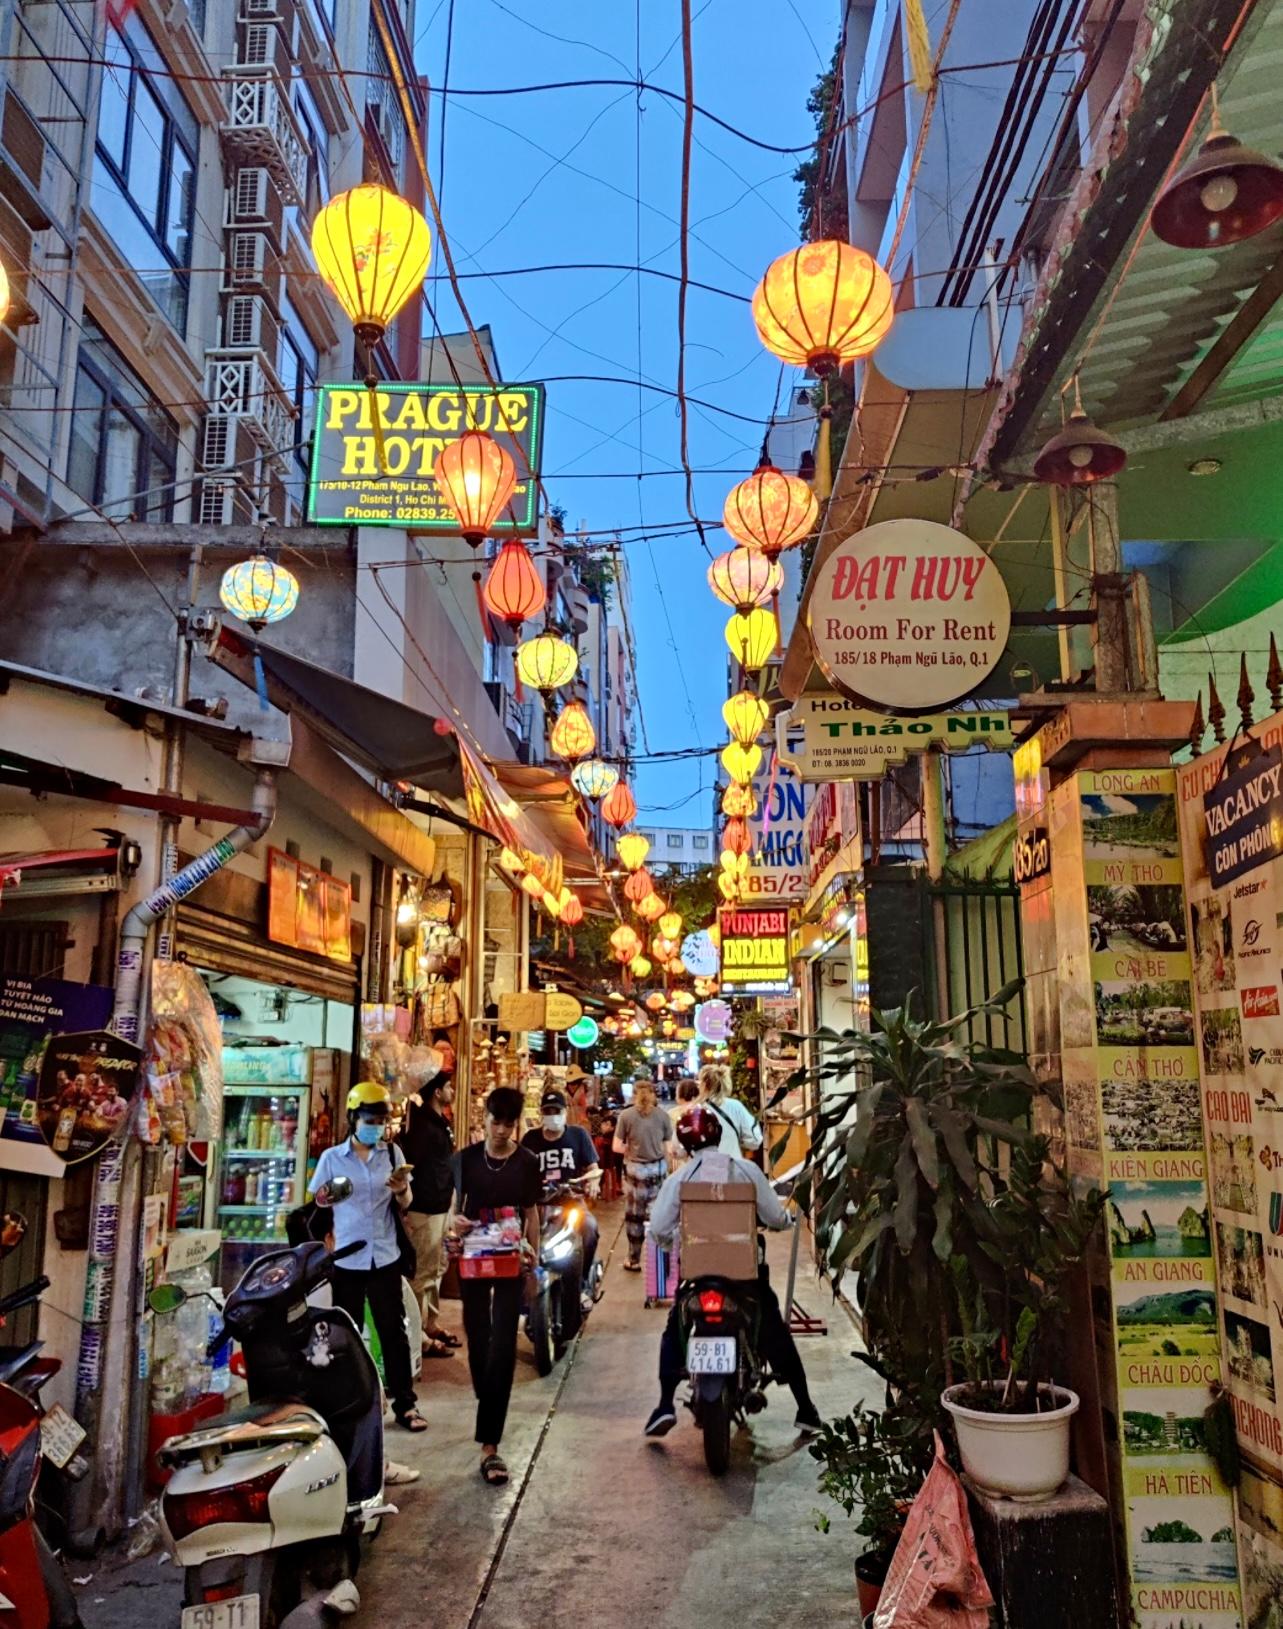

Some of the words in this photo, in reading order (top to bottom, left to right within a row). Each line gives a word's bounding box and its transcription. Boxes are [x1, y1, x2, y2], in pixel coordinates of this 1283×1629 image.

[326, 391, 528, 432] PRAGUE
[341, 436, 461, 476] HOT
[362, 481, 388, 490] Pham
[390, 482, 409, 492] Ngu
[360, 495, 393, 504] District
[420, 495, 436, 505] Chi
[344, 507, 392, 518] Phone:
[832, 556, 906, 611] ĐẠT
[911, 556, 986, 601] HUY
[825, 618, 888, 641] Room
[896, 618, 936, 641] For
[943, 618, 997, 641] Rent
[834, 651, 877, 665] 185/18
[880, 651, 912, 667] Phạm
[969, 651, 988, 667] Q.1
[811, 700, 864, 712] Hote
[820, 718, 934, 737] Thảo
[1093, 775, 1134, 791] LONG
[1139, 775, 1160, 790] AN
[1205, 763, 1282, 837] VACANCY
[1233, 882, 1260, 899] Jetstar
[721, 911, 786, 937] PUNJABI
[722, 938, 786, 965] INDIAN
[17, 981, 32, 990] BIA
[47, 1007, 64, 1017] GIA
[1205, 1090, 1229, 1121] CAO
[1153, 1159, 1203, 1178] GIANG
[1124, 1264, 1147, 1281] AN
[1152, 1262, 1203, 1281] GIANG
[1128, 1361, 1174, 1384] CHÂU
[1137, 1590, 1239, 1610] CAMPUCHIA
